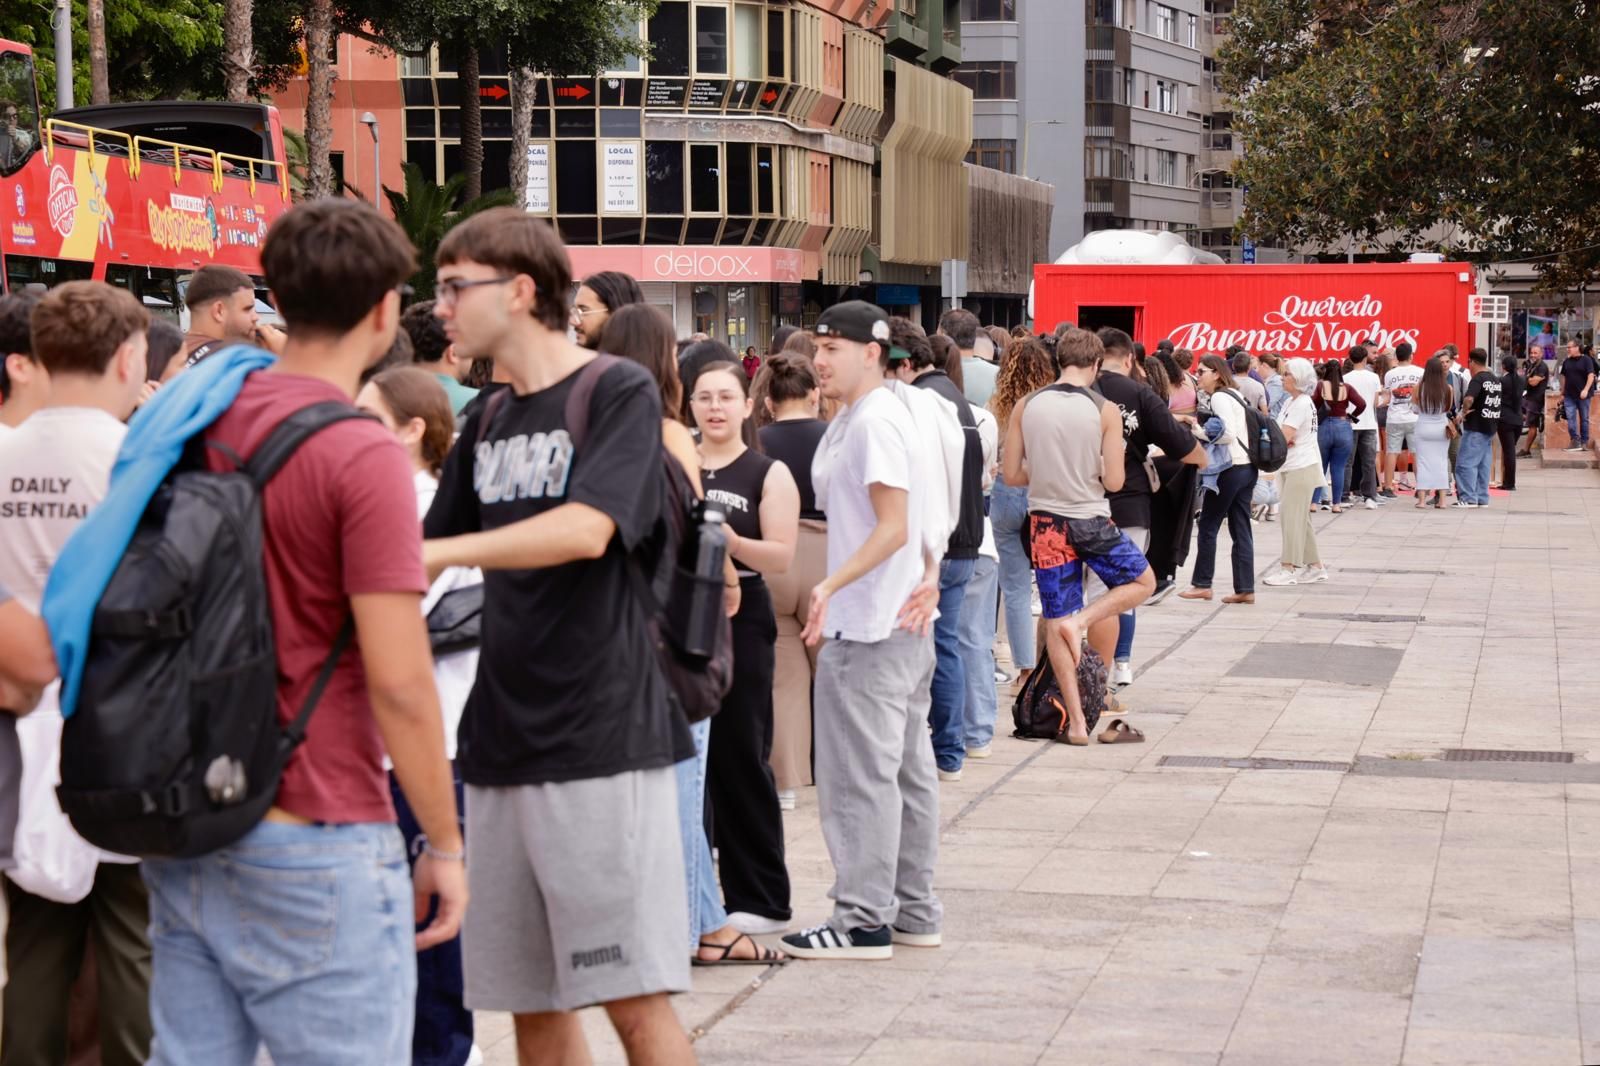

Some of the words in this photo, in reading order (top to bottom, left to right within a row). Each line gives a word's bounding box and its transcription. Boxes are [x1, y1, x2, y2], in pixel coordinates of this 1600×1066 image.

[1263, 294, 1383, 328] Quevedo
[1167, 322, 1304, 352] Buenas
[1306, 320, 1420, 353] Noches
[472, 429, 575, 504] PUMA
[11, 477, 71, 494] DAILY
[705, 489, 749, 513] SUNSET
[571, 943, 623, 970] PUMA
